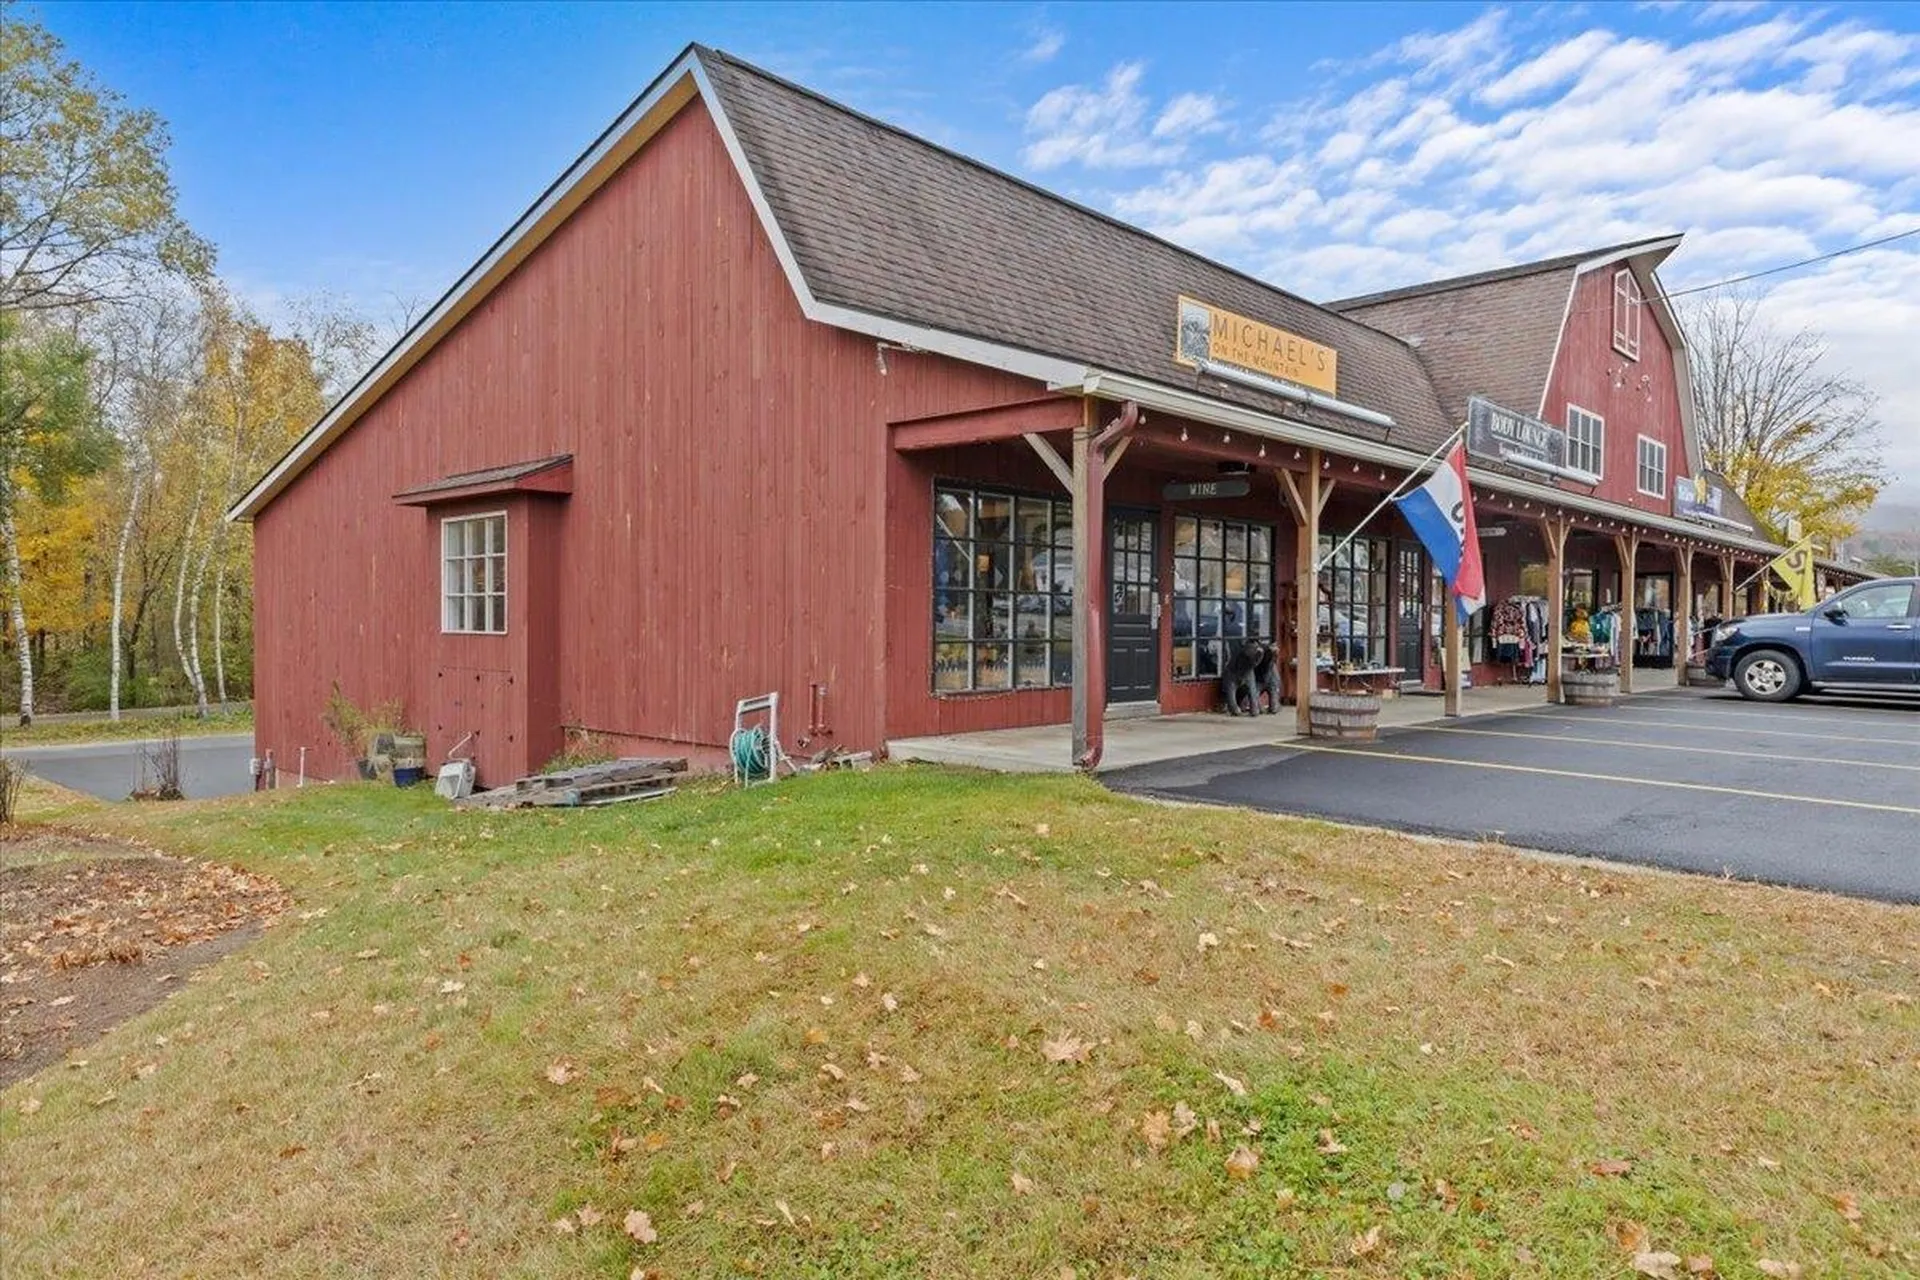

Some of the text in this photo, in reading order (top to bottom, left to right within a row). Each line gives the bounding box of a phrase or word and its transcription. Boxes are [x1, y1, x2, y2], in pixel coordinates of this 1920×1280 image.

[1213, 313, 1325, 372] MICHAEL'S
[1213, 342, 1228, 355] ON
[1232, 347, 1248, 362] THE
[1491, 411, 1514, 438] BODY
[1189, 482, 1217, 496] WINE
